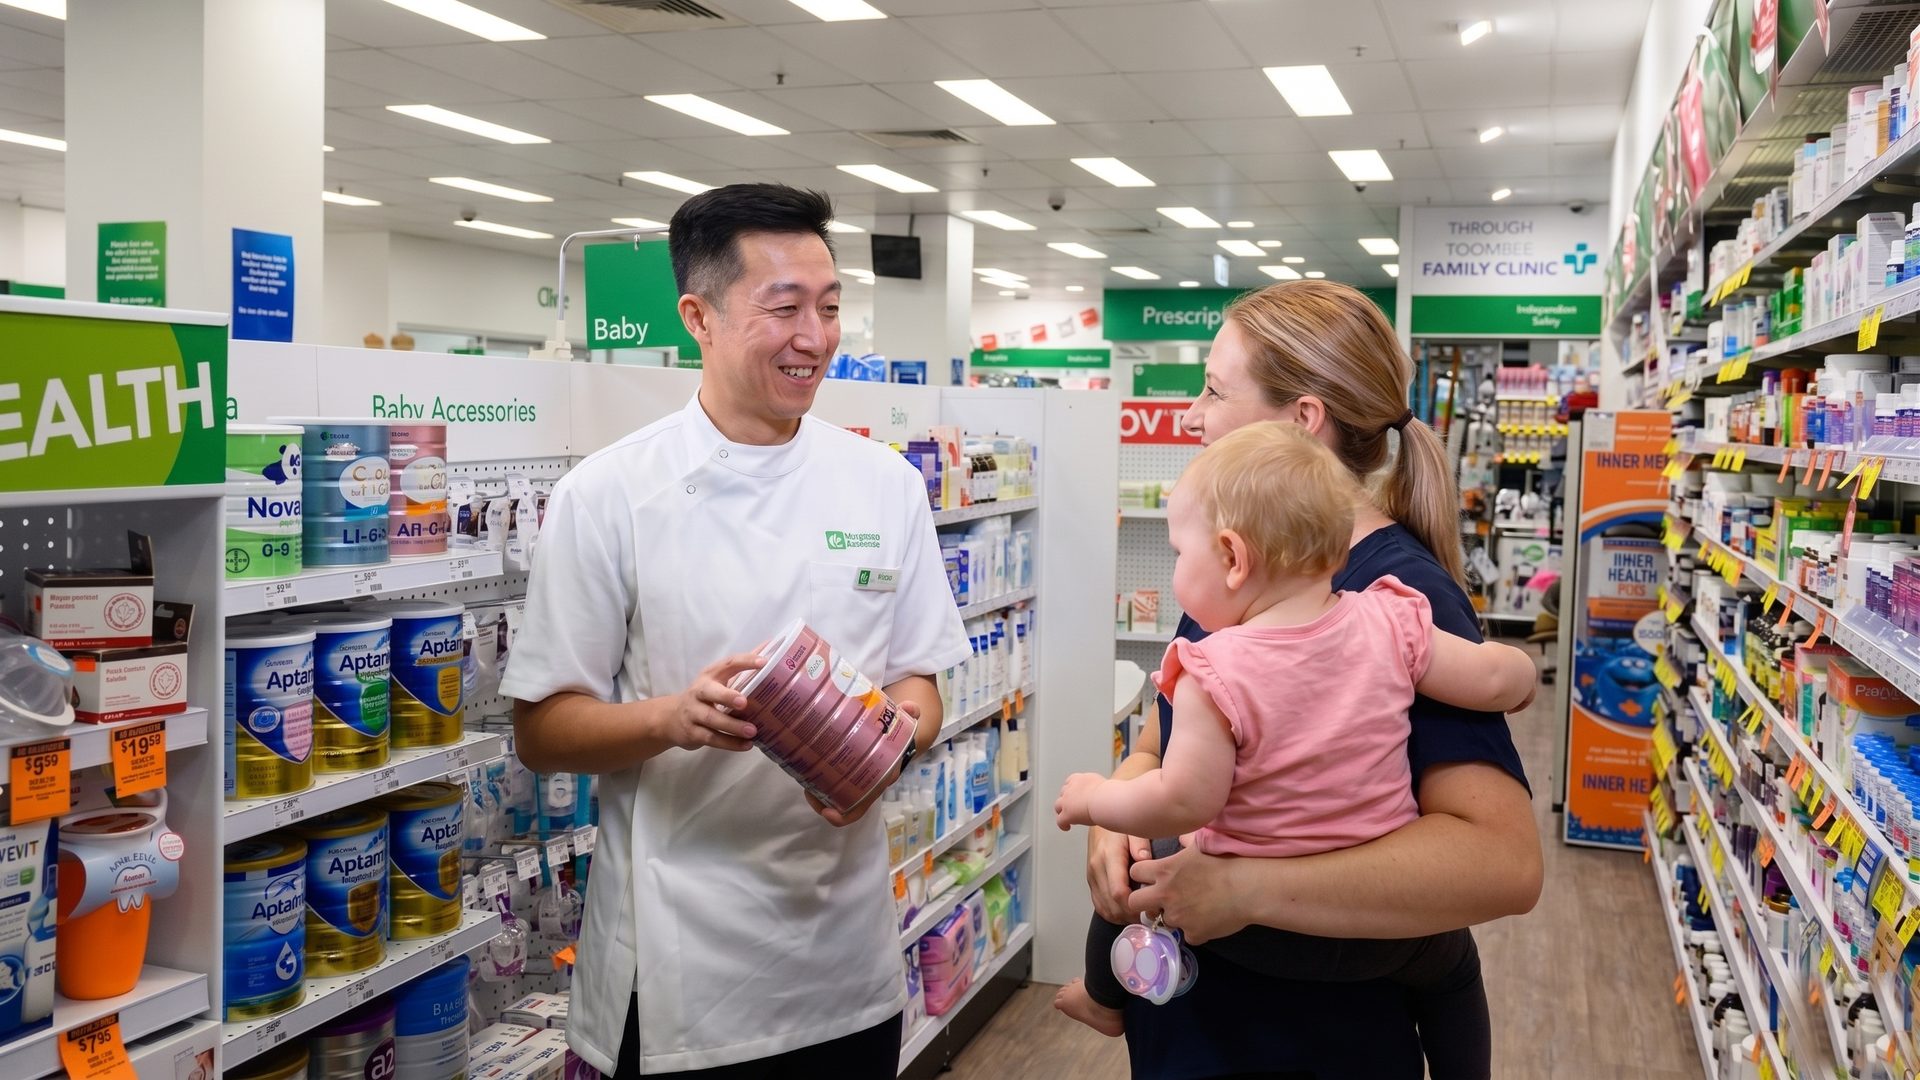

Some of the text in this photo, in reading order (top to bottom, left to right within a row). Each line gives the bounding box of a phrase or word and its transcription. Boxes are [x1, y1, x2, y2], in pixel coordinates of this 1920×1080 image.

[1449, 221, 1533, 235] THROUGH
[1446, 242, 1533, 257] TOOMBEE
[1422, 262, 1558, 276] FAMILY CLINIC
[1143, 306, 1223, 330] Prescrip
[594, 316, 648, 345] Baby
[372, 394, 536, 423] Baby Accessories
[247, 497, 301, 518] Nova
[1608, 568, 1658, 584] HEALTH
[1583, 773, 1653, 795] INNER HE
[371, 1047, 395, 1080] a2
